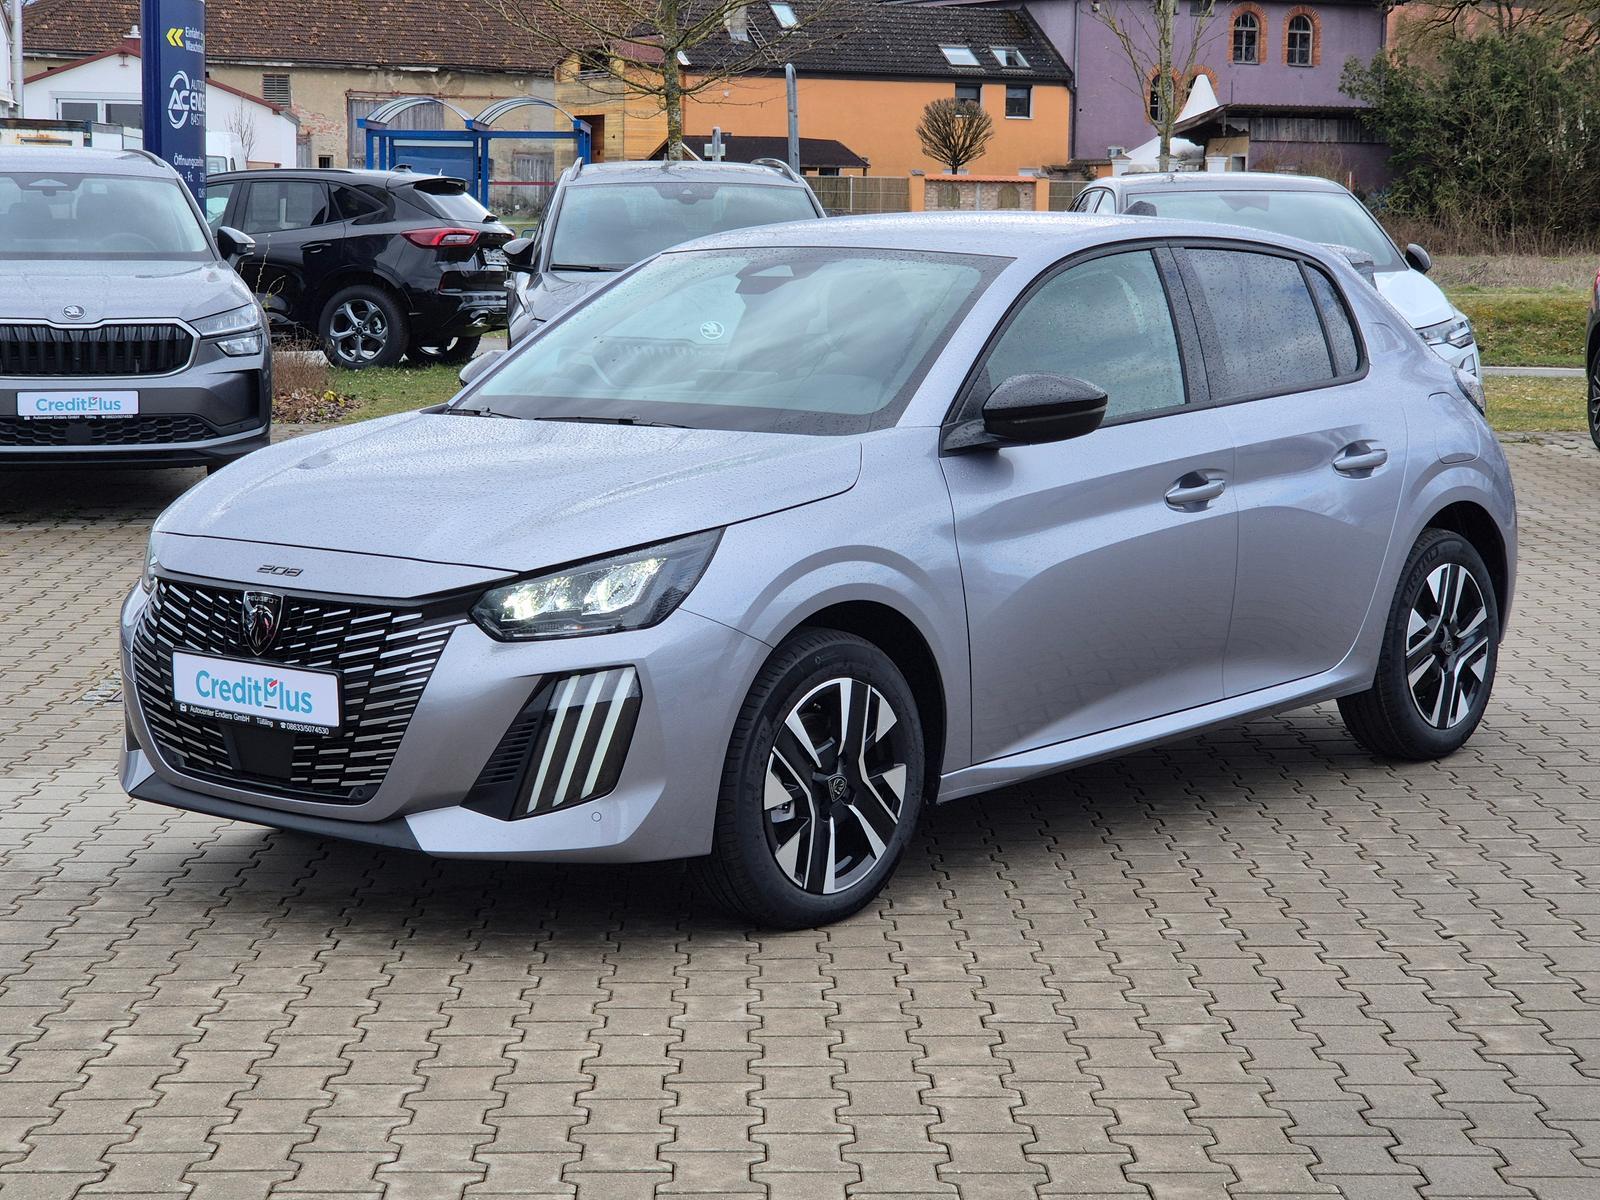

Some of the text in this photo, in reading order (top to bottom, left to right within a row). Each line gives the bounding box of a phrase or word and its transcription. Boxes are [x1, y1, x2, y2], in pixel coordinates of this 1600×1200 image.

[36, 396, 122, 412] CreditPlus
[256, 564, 304, 577] 208
[196, 669, 313, 714] CreditPlus
[189, 705, 215, 717] Autocenter
[214, 709, 233, 720] Enders
[233, 713, 251, 723] GmbH
[286, 722, 330, 735] 08633/5074530
